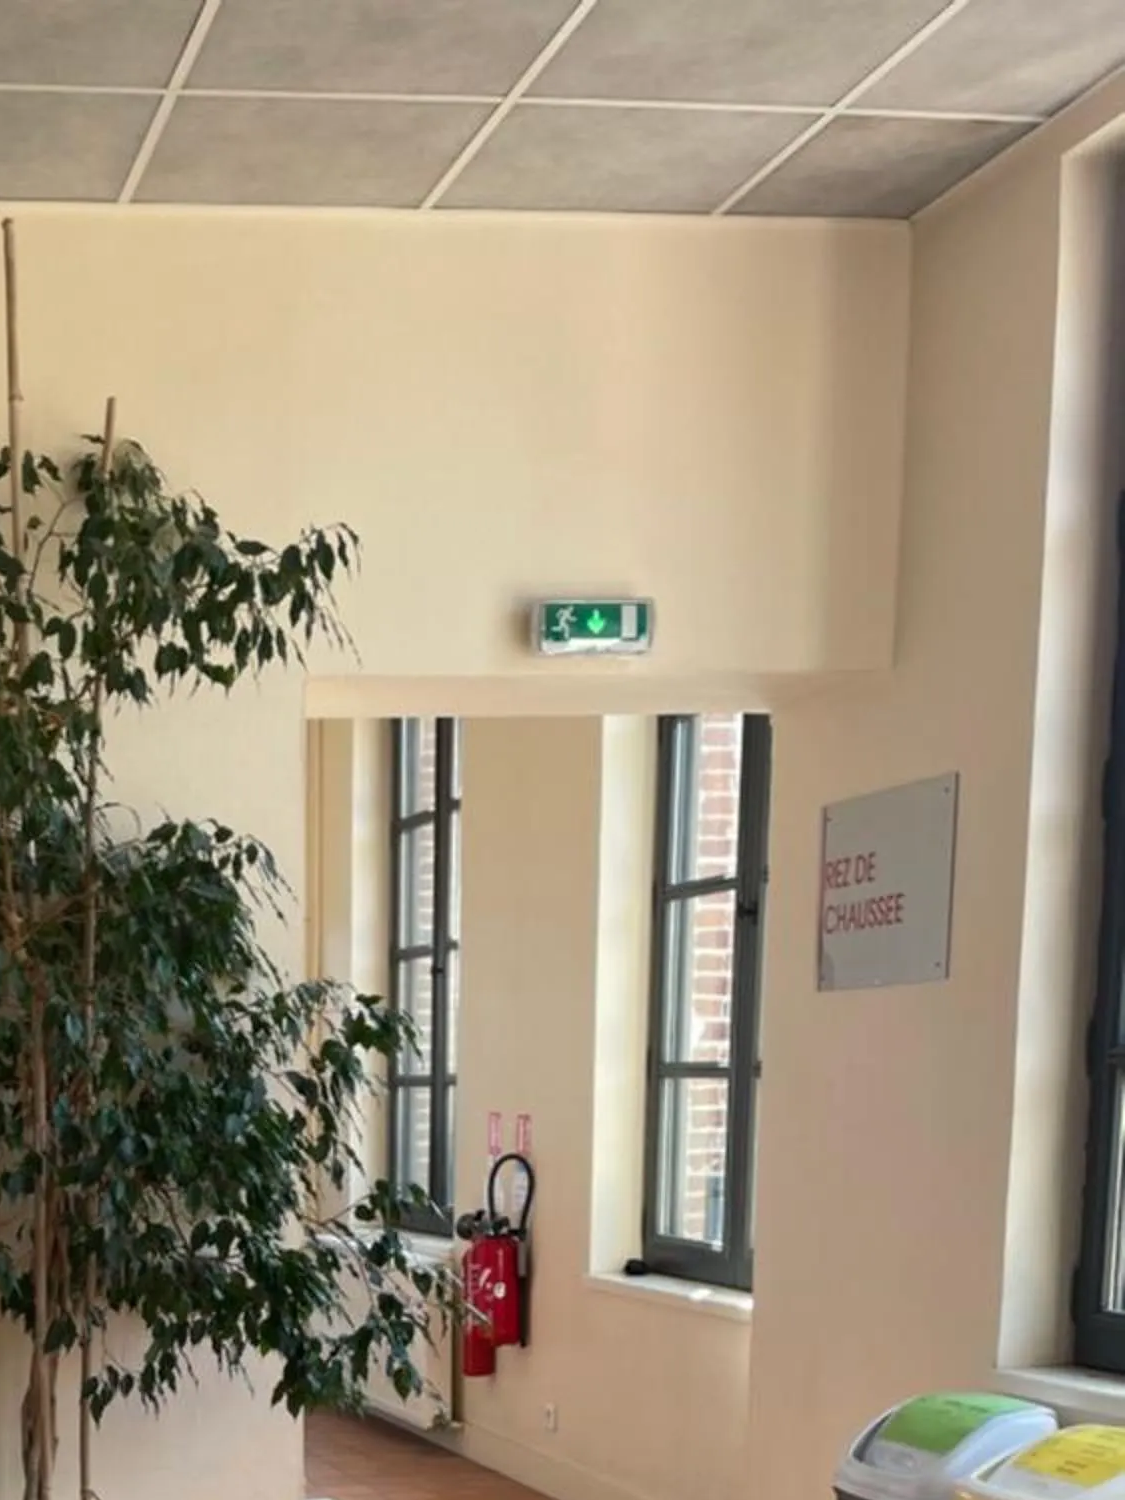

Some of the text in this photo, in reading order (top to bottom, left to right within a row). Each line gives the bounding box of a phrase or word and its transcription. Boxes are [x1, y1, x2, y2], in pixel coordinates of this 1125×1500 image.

[824, 852, 876, 889] REZ DE
[825, 893, 905, 934] CHAUSSEE
